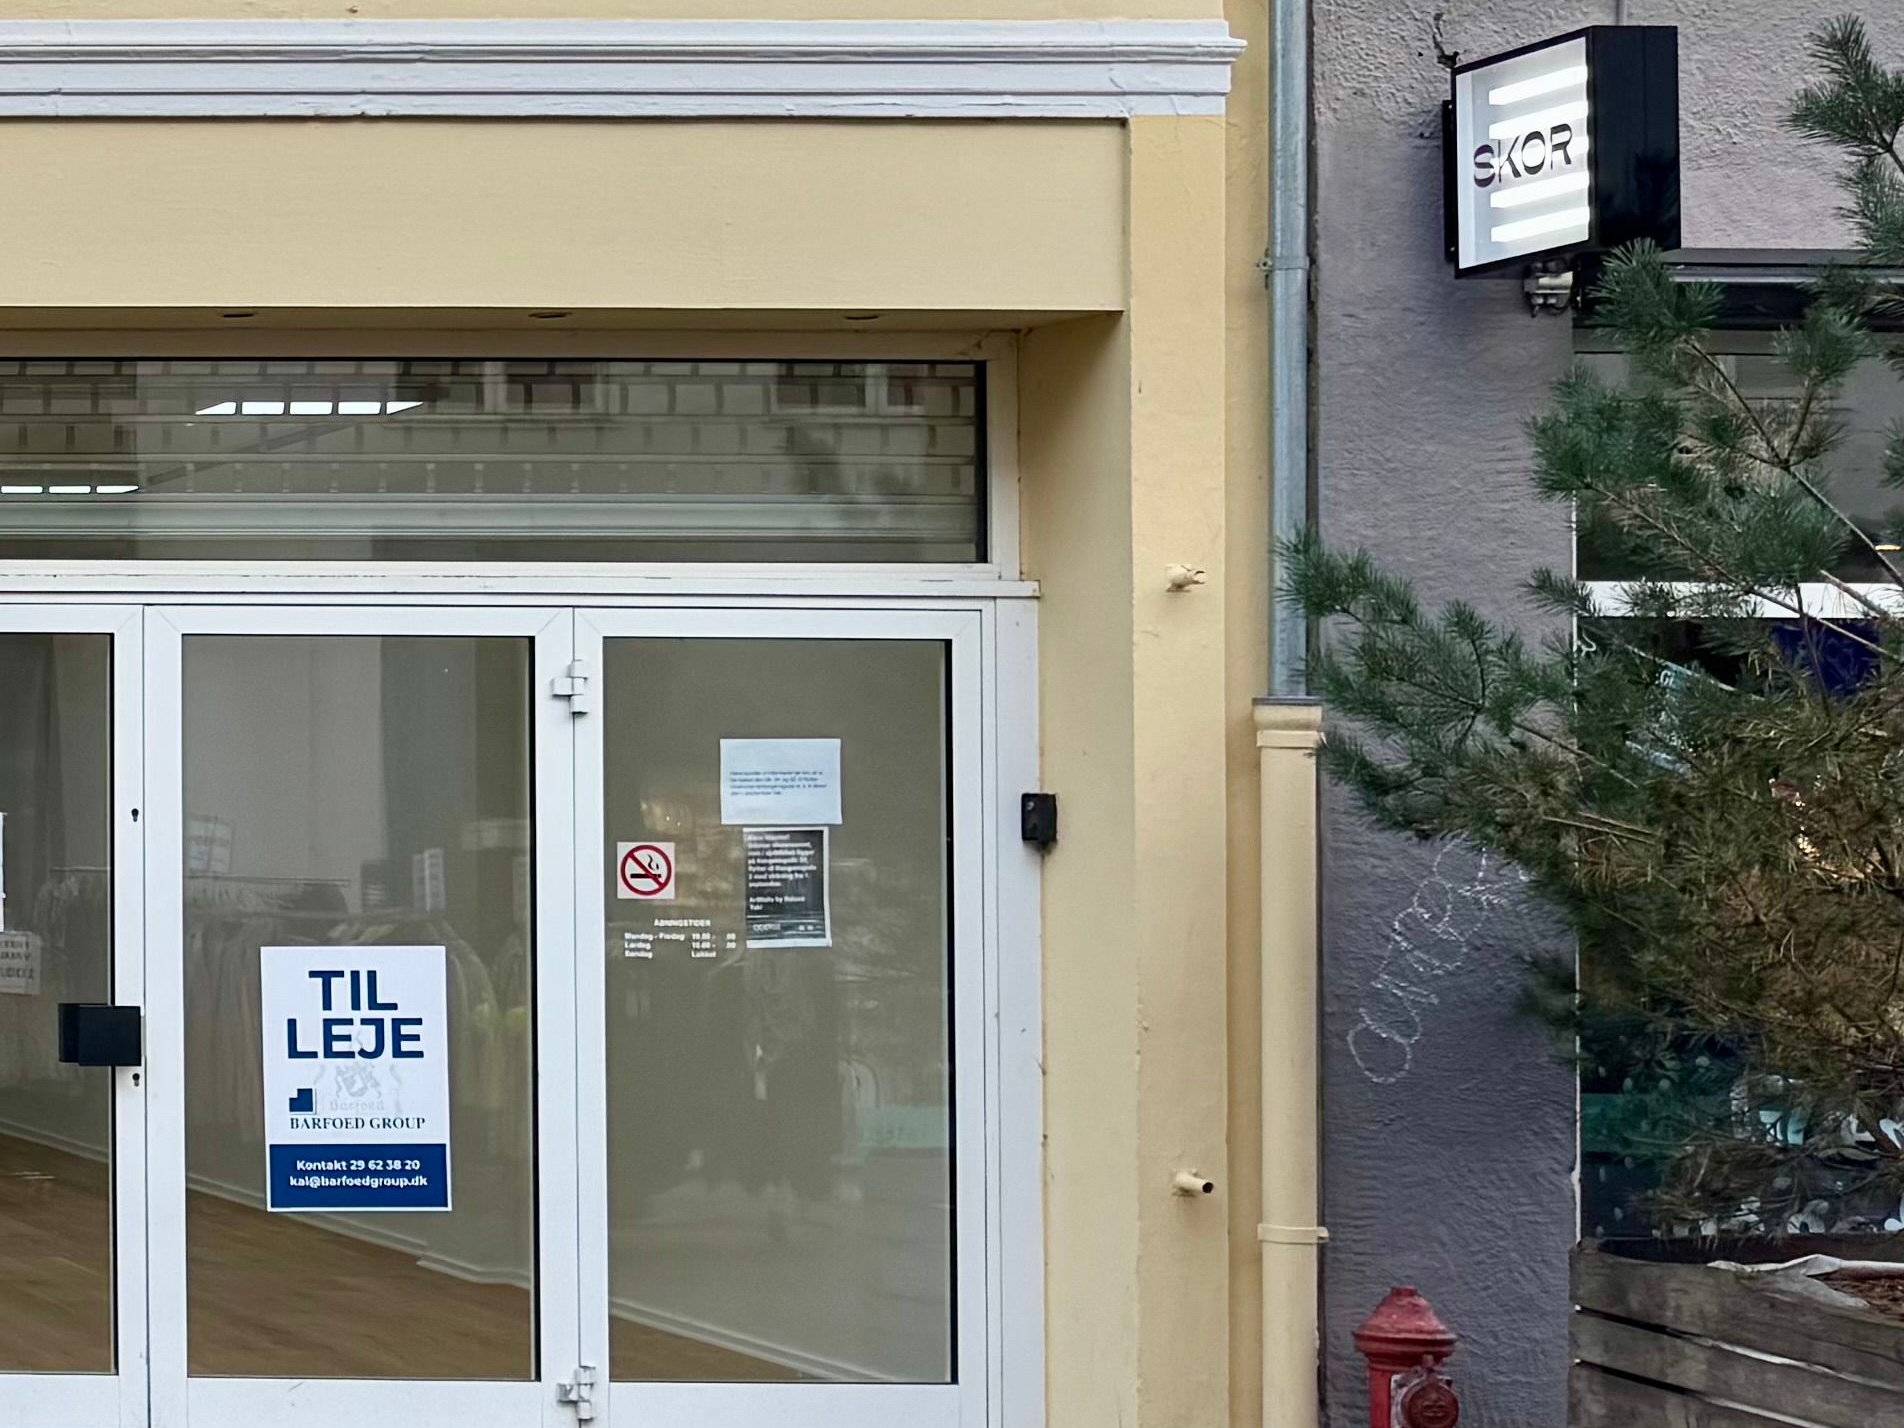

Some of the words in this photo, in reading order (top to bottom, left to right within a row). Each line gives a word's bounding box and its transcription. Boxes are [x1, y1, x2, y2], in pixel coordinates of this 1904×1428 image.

[1473, 122, 1573, 188] SKOR
[308, 970, 398, 1011] TIL
[287, 1018, 424, 1059] LEJE
[290, 1116, 365, 1130] BARFOED
[369, 1116, 426, 1130] GROUP
[296, 1159, 347, 1171] Kontakt
[349, 1159, 365, 1171] 29
[368, 1159, 383, 1171] 62
[386, 1159, 402, 1171] 38
[404, 1159, 420, 1171] 20
